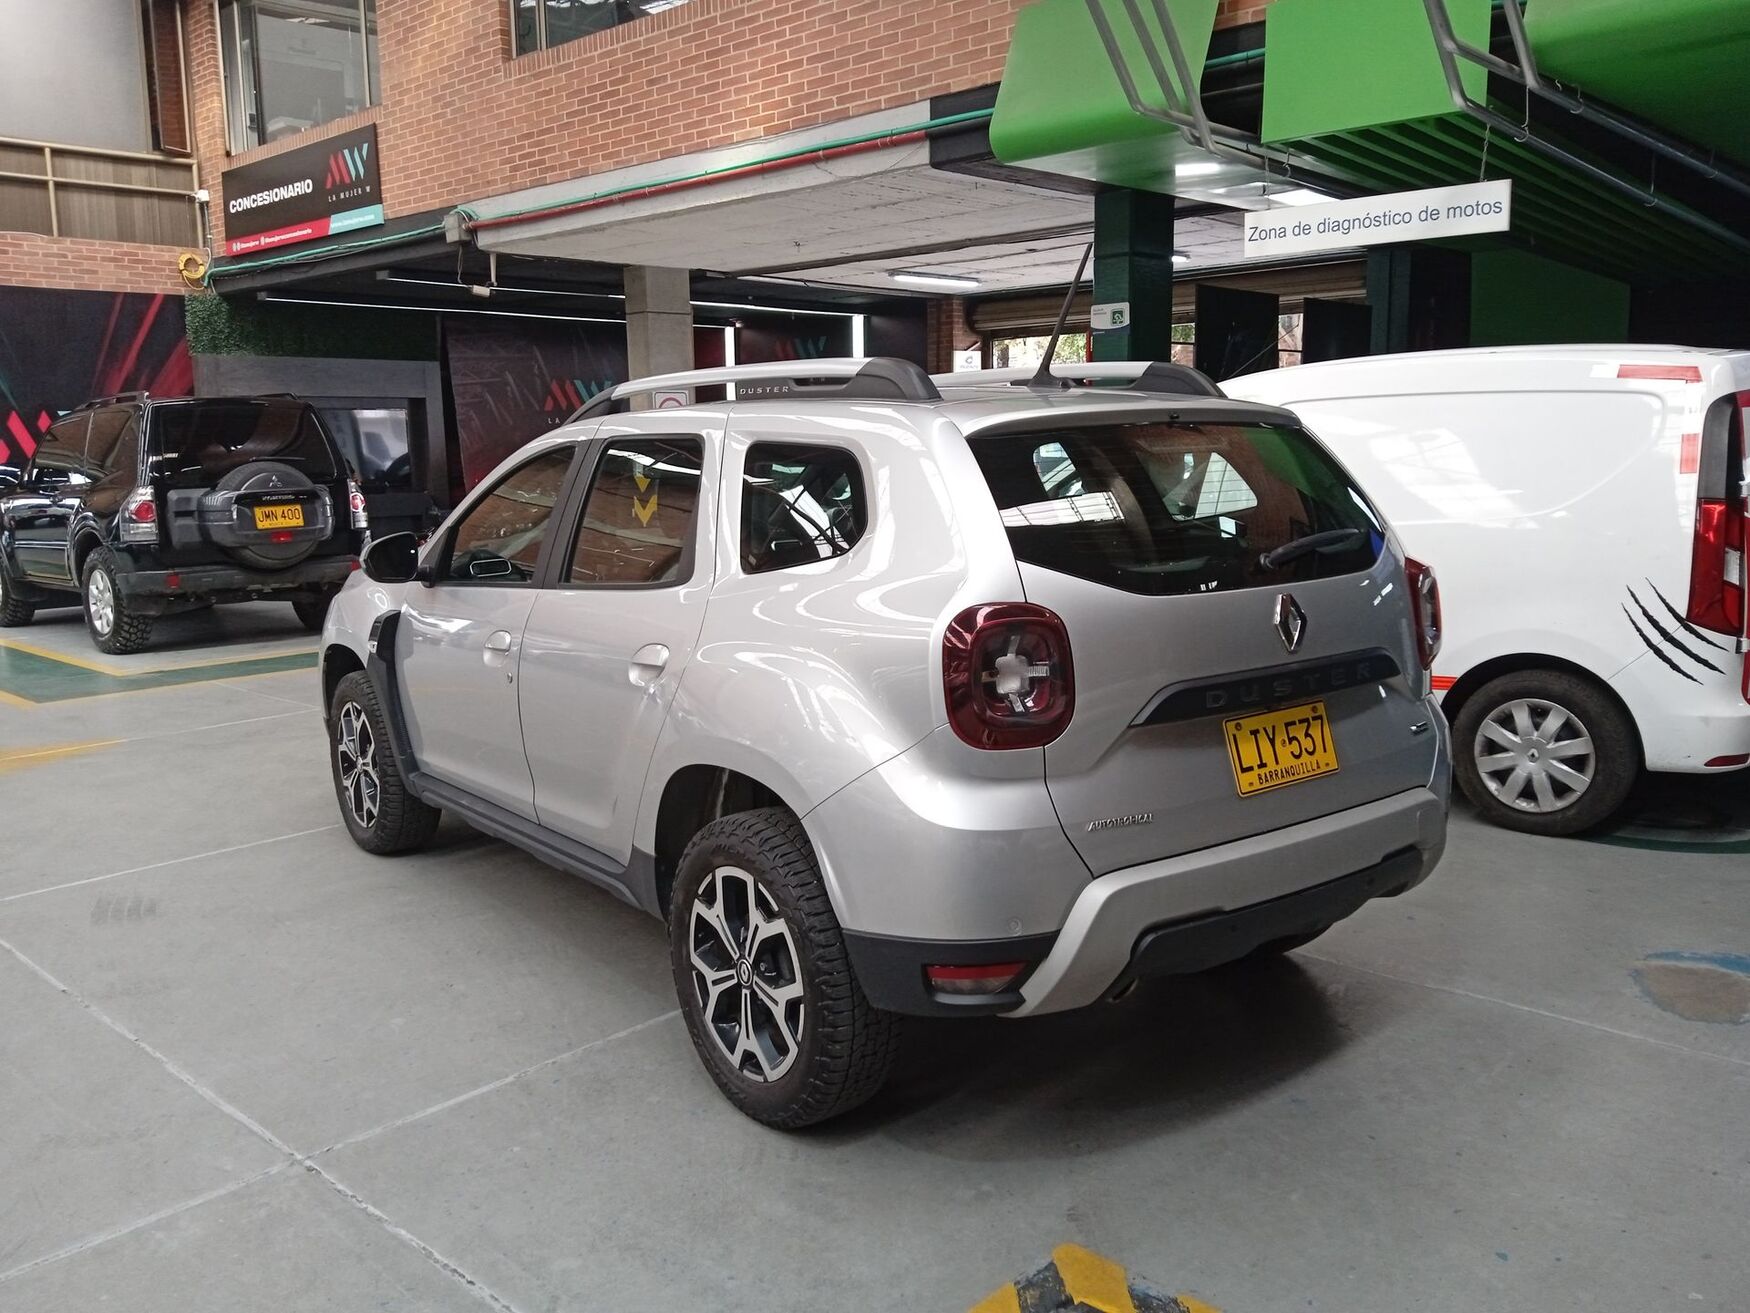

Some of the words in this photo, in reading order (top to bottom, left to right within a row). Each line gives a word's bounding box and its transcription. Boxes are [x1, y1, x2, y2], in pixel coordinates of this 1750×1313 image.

[229, 178, 313, 214] CONCESIONARIO
[328, 192, 337, 202] LA
[340, 187, 362, 199] MUJER
[1248, 225, 1287, 242] Zona
[1292, 220, 1312, 237] de
[1317, 209, 1412, 235] diagnóstico
[1418, 205, 1440, 222] de
[1446, 200, 1503, 219] motos
[740, 385, 789, 395] DUSTER
[258, 509, 278, 522] JMN
[280, 507, 301, 521] 400
[1206, 661, 1372, 709] DUSTER
[1257, 760, 1321, 785] BARRANQUILLA
